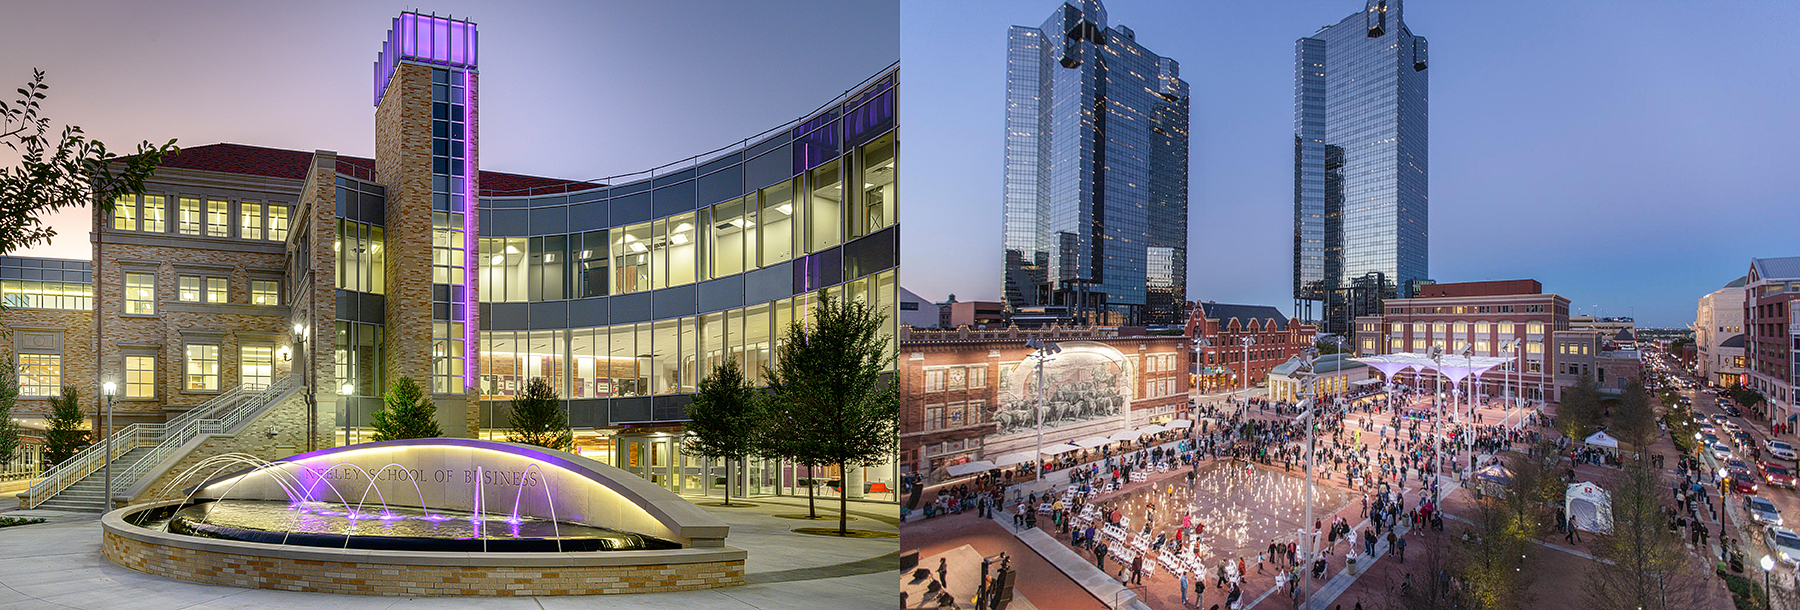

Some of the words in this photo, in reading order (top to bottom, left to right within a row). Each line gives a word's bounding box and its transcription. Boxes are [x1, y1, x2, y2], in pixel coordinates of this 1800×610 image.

[305, 468, 361, 480] NEELEY
[368, 468, 427, 482] SCHOOL
[434, 469, 453, 483] OF
[463, 469, 537, 487] BUSINESS
